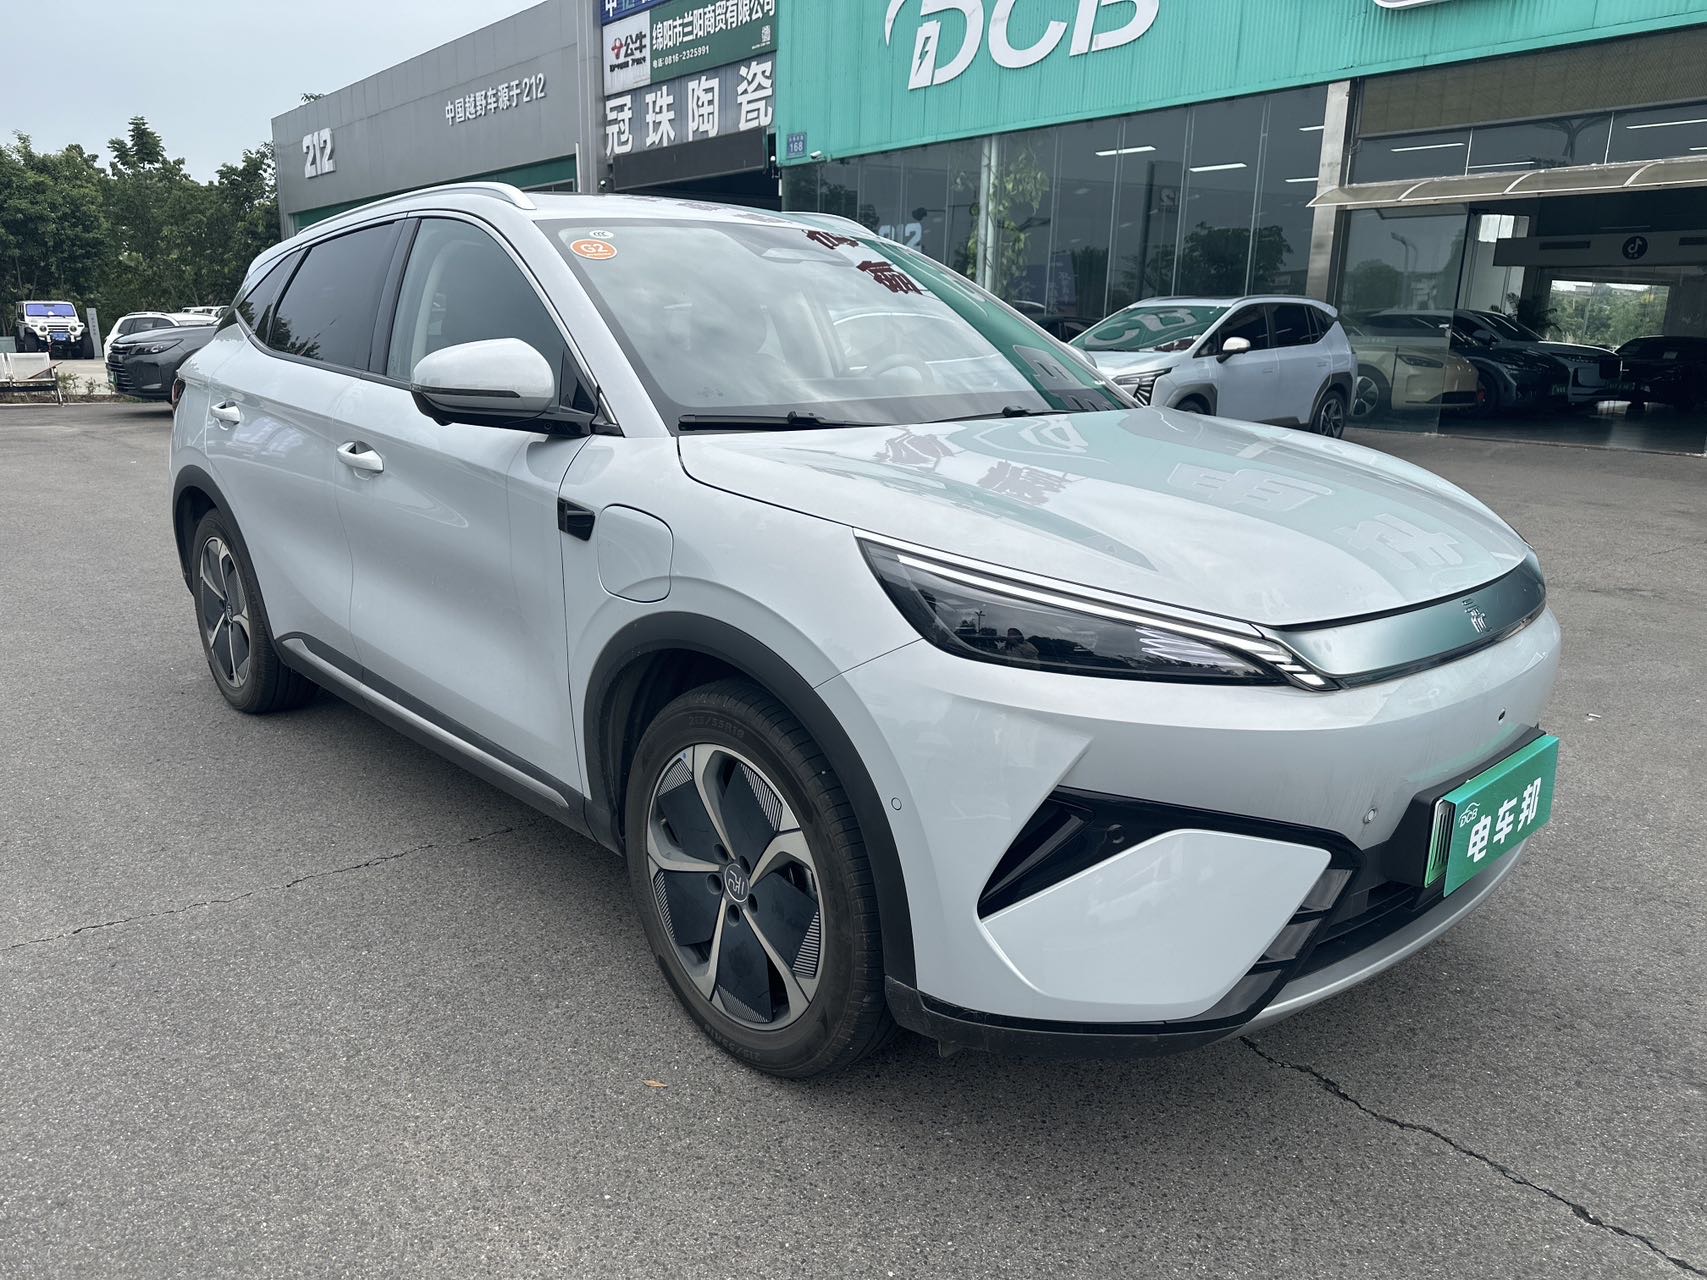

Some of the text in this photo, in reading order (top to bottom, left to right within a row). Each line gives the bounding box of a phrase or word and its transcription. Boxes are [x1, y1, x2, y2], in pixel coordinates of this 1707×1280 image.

[624, 31, 647, 58] 公牛
[907, 0, 1160, 90] DCB
[605, 61, 773, 156] 冠珠陶瓷
[303, 128, 336, 178] 212
[790, 141, 803, 152] 168
[580, 243, 608, 253] G2
[1466, 777, 1542, 863] 电车邦
